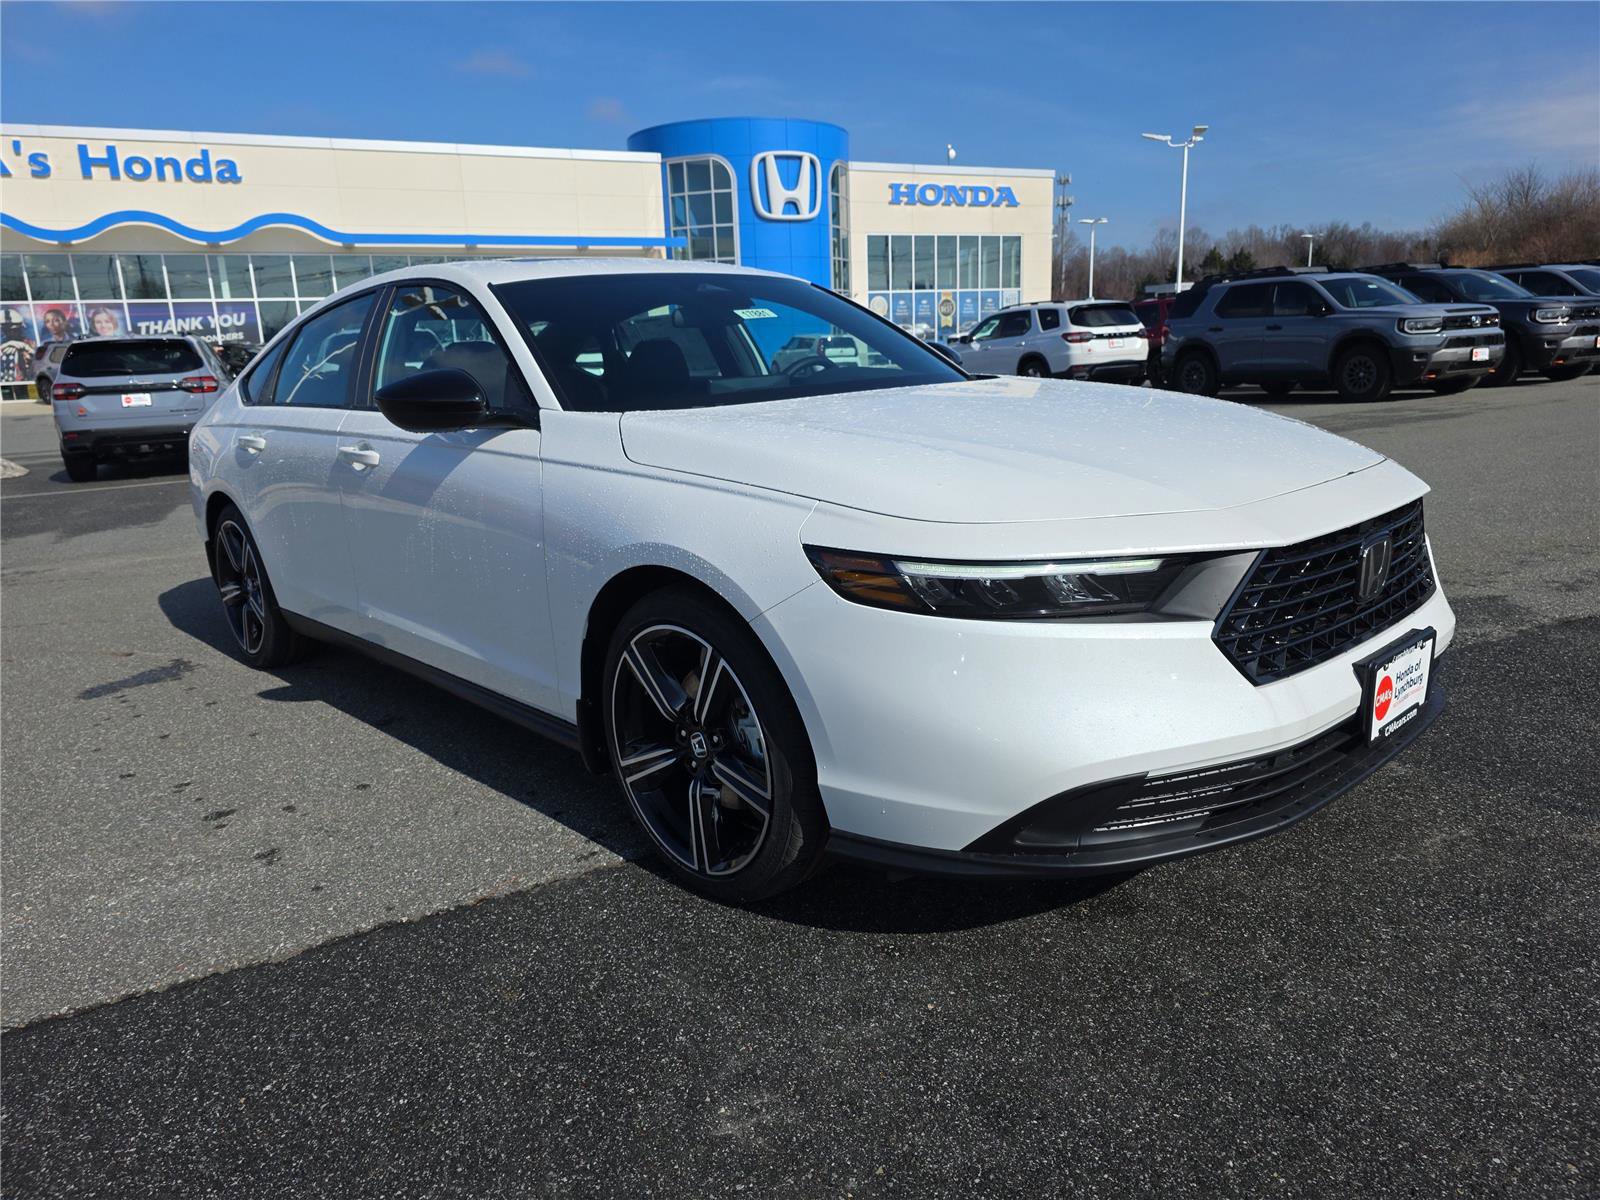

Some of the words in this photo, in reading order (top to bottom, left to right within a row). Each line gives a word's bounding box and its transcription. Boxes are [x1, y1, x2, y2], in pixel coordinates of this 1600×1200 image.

[77, 144, 242, 184] Honda
[888, 183, 1020, 207] HONDA
[137, 316, 203, 336] THANK
[207, 312, 246, 329] YOU
[1395, 664, 1414, 684] Honda
[1414, 658, 1422, 672] of
[1394, 673, 1424, 700] Lynchburg
